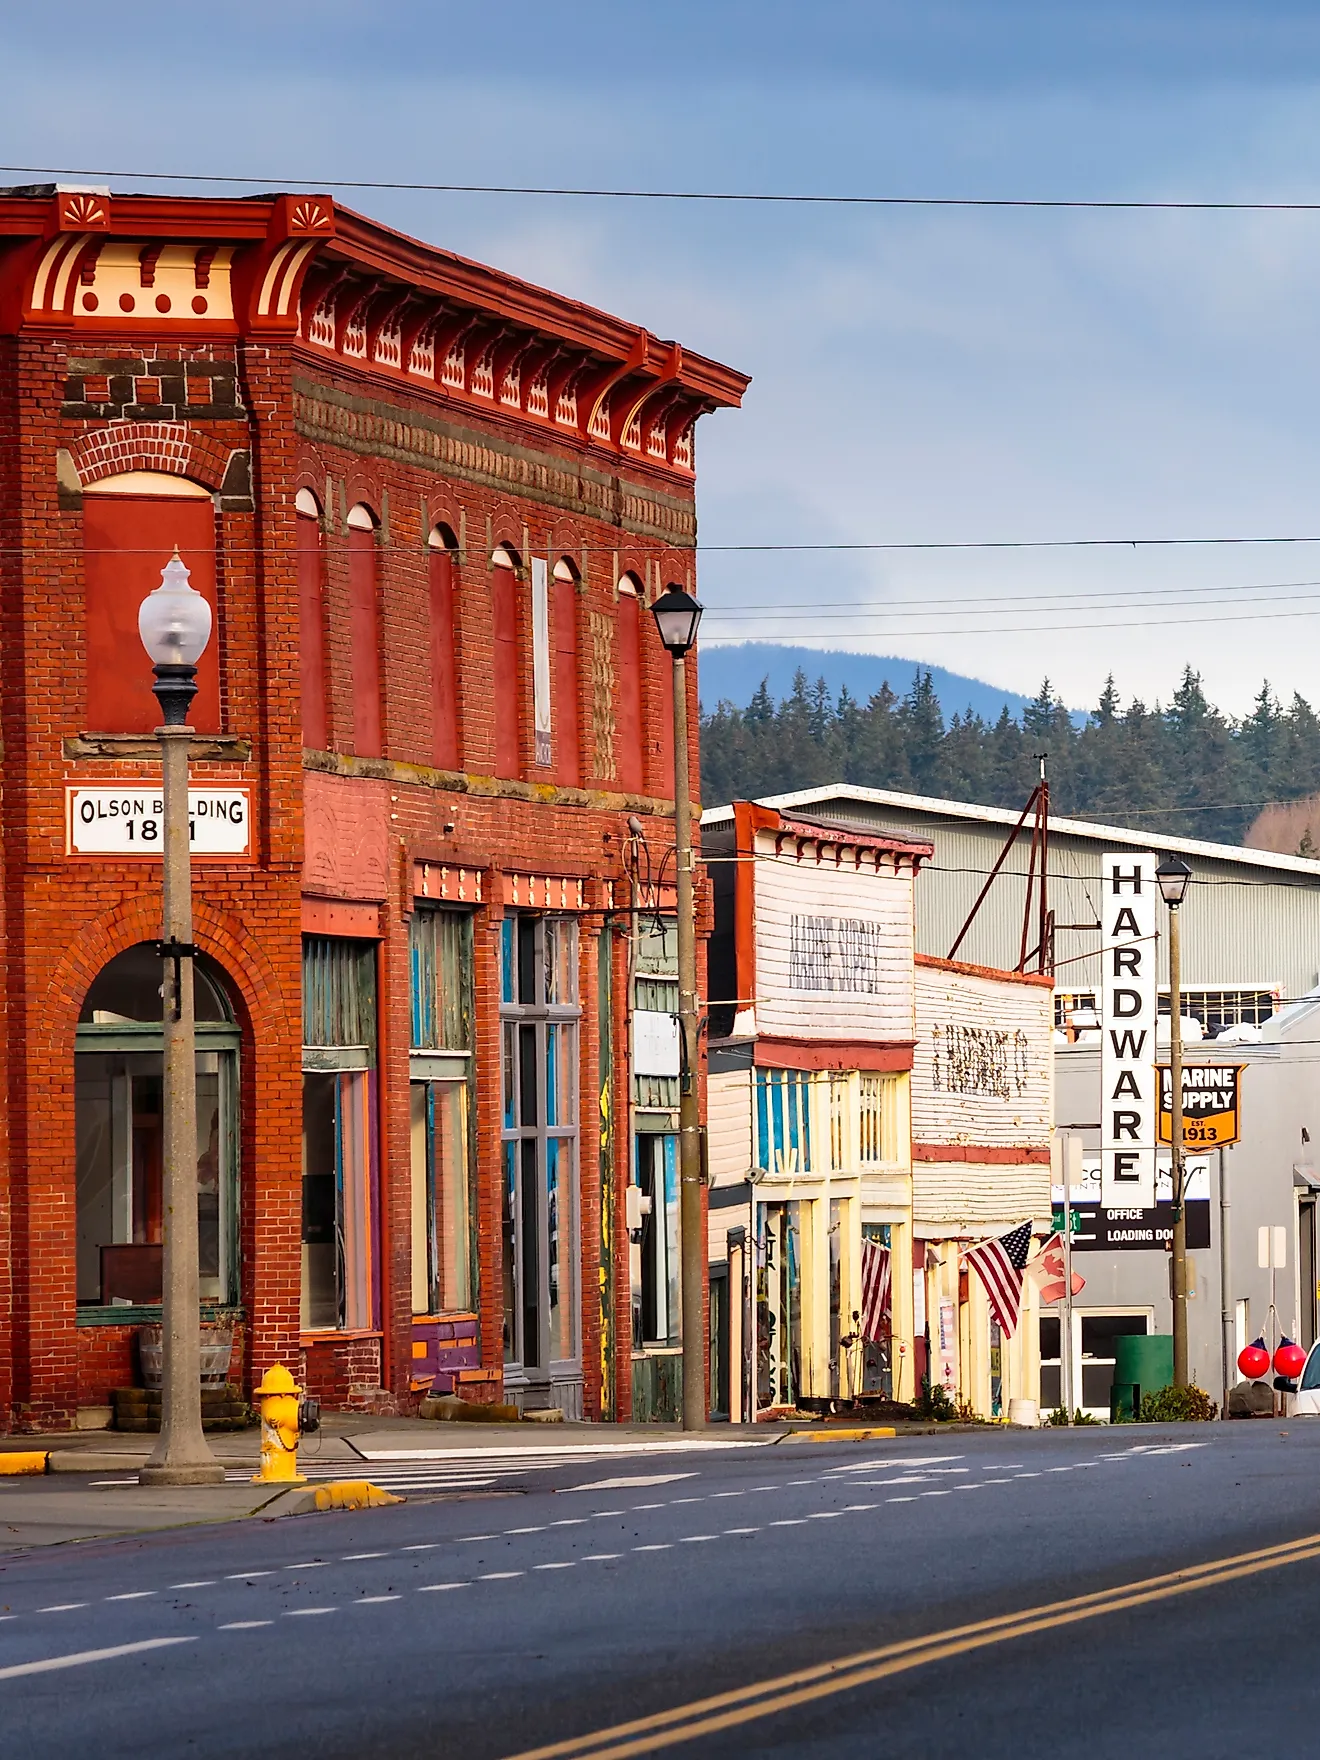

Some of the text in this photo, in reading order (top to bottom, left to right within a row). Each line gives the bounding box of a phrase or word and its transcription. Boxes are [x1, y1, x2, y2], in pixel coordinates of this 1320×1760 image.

[81, 800, 243, 823] OLSON BDING
[126, 820, 195, 841] 181
[1110, 864, 1148, 1181] HARDWARE
[1183, 1128, 1217, 1141] 1913
[1107, 1209, 1143, 1220] OFFICE
[1107, 1229, 1174, 1241] LOADING DO
